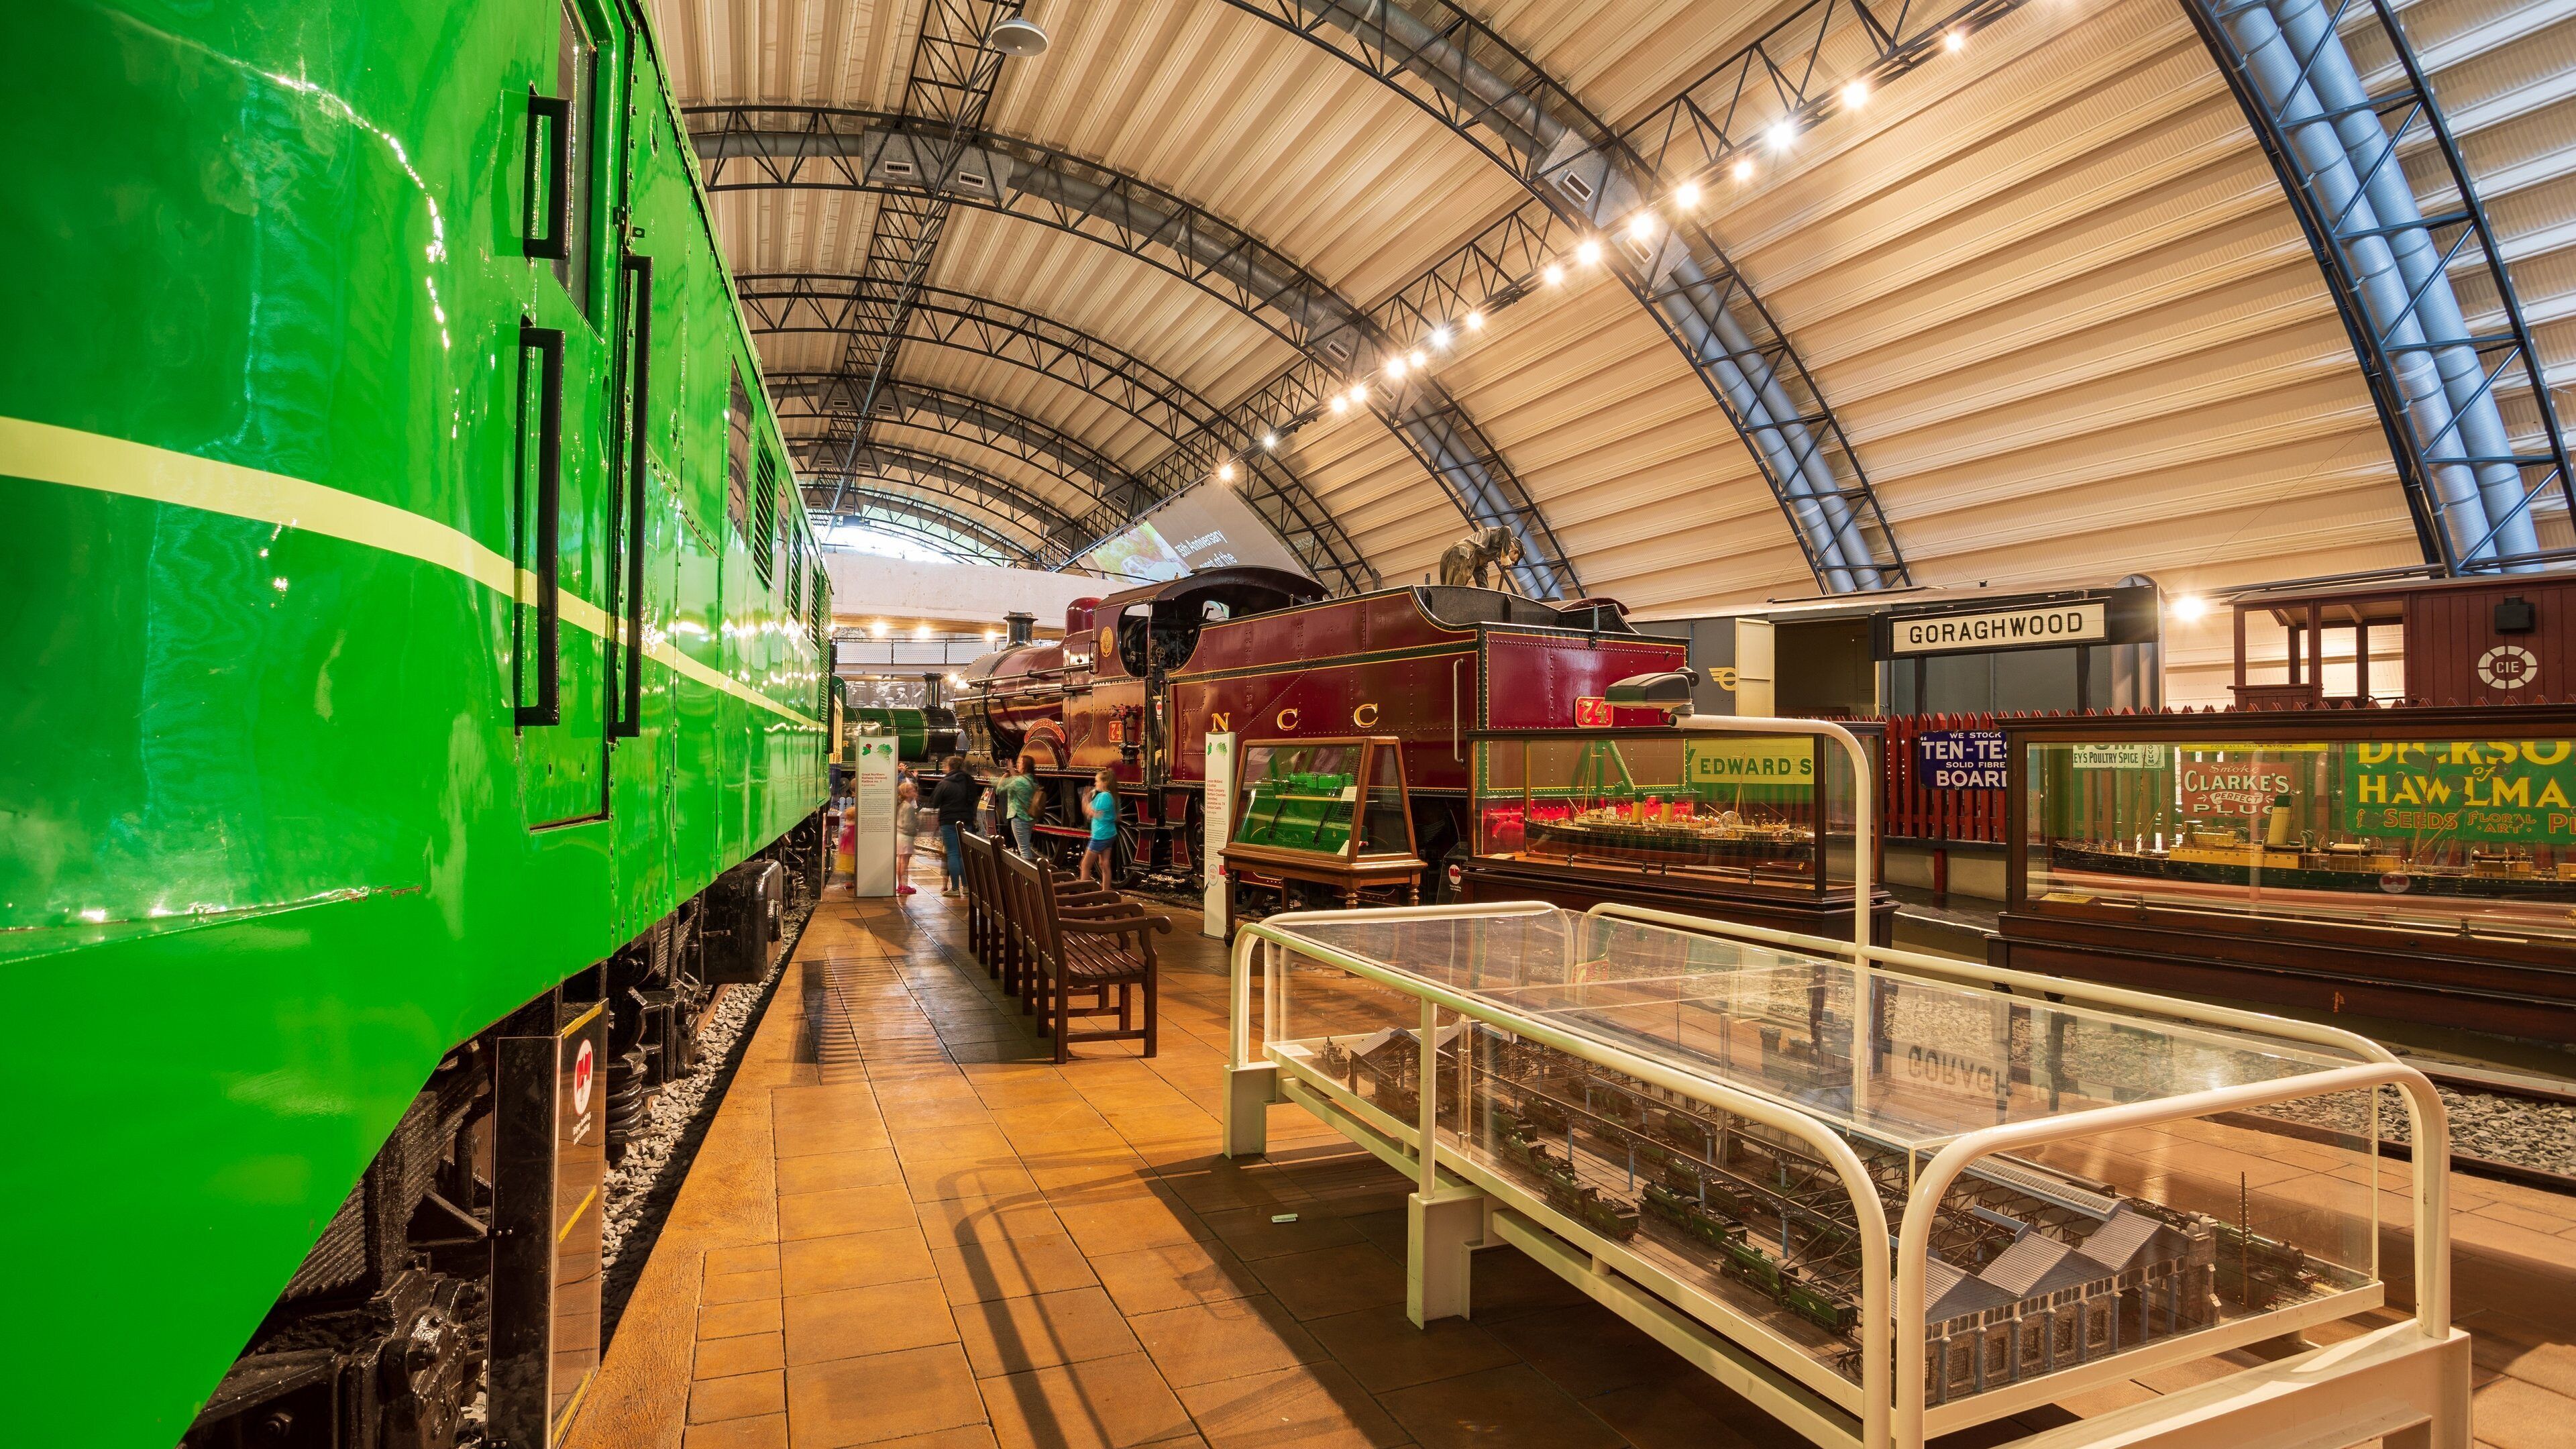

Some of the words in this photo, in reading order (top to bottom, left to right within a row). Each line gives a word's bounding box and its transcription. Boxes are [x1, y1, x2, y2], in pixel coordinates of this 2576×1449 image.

[1185, 530, 1228, 552] Anniversary
[1214, 553, 1226, 568] of
[1219, 551, 1238, 567] the
[1909, 612, 2083, 644] GORAGHWOOD
[2496, 661, 2519, 673] CIE
[1212, 712, 1230, 732] N
[1277, 708, 1299, 731] C
[1354, 703, 1379, 729] C
[1582, 700, 1607, 724] 74
[2073, 752, 2087, 763] EY'S
[2089, 752, 2117, 763] POULTRY
[2118, 751, 2138, 763] SPICE
[2209, 764, 2259, 773] Smoke
[2184, 770, 2290, 794] CLARKE'S
[2214, 793, 2260, 804] PERFECT
[2383, 808, 2458, 830] SEEDS
[2467, 810, 2537, 825] FLORAL
